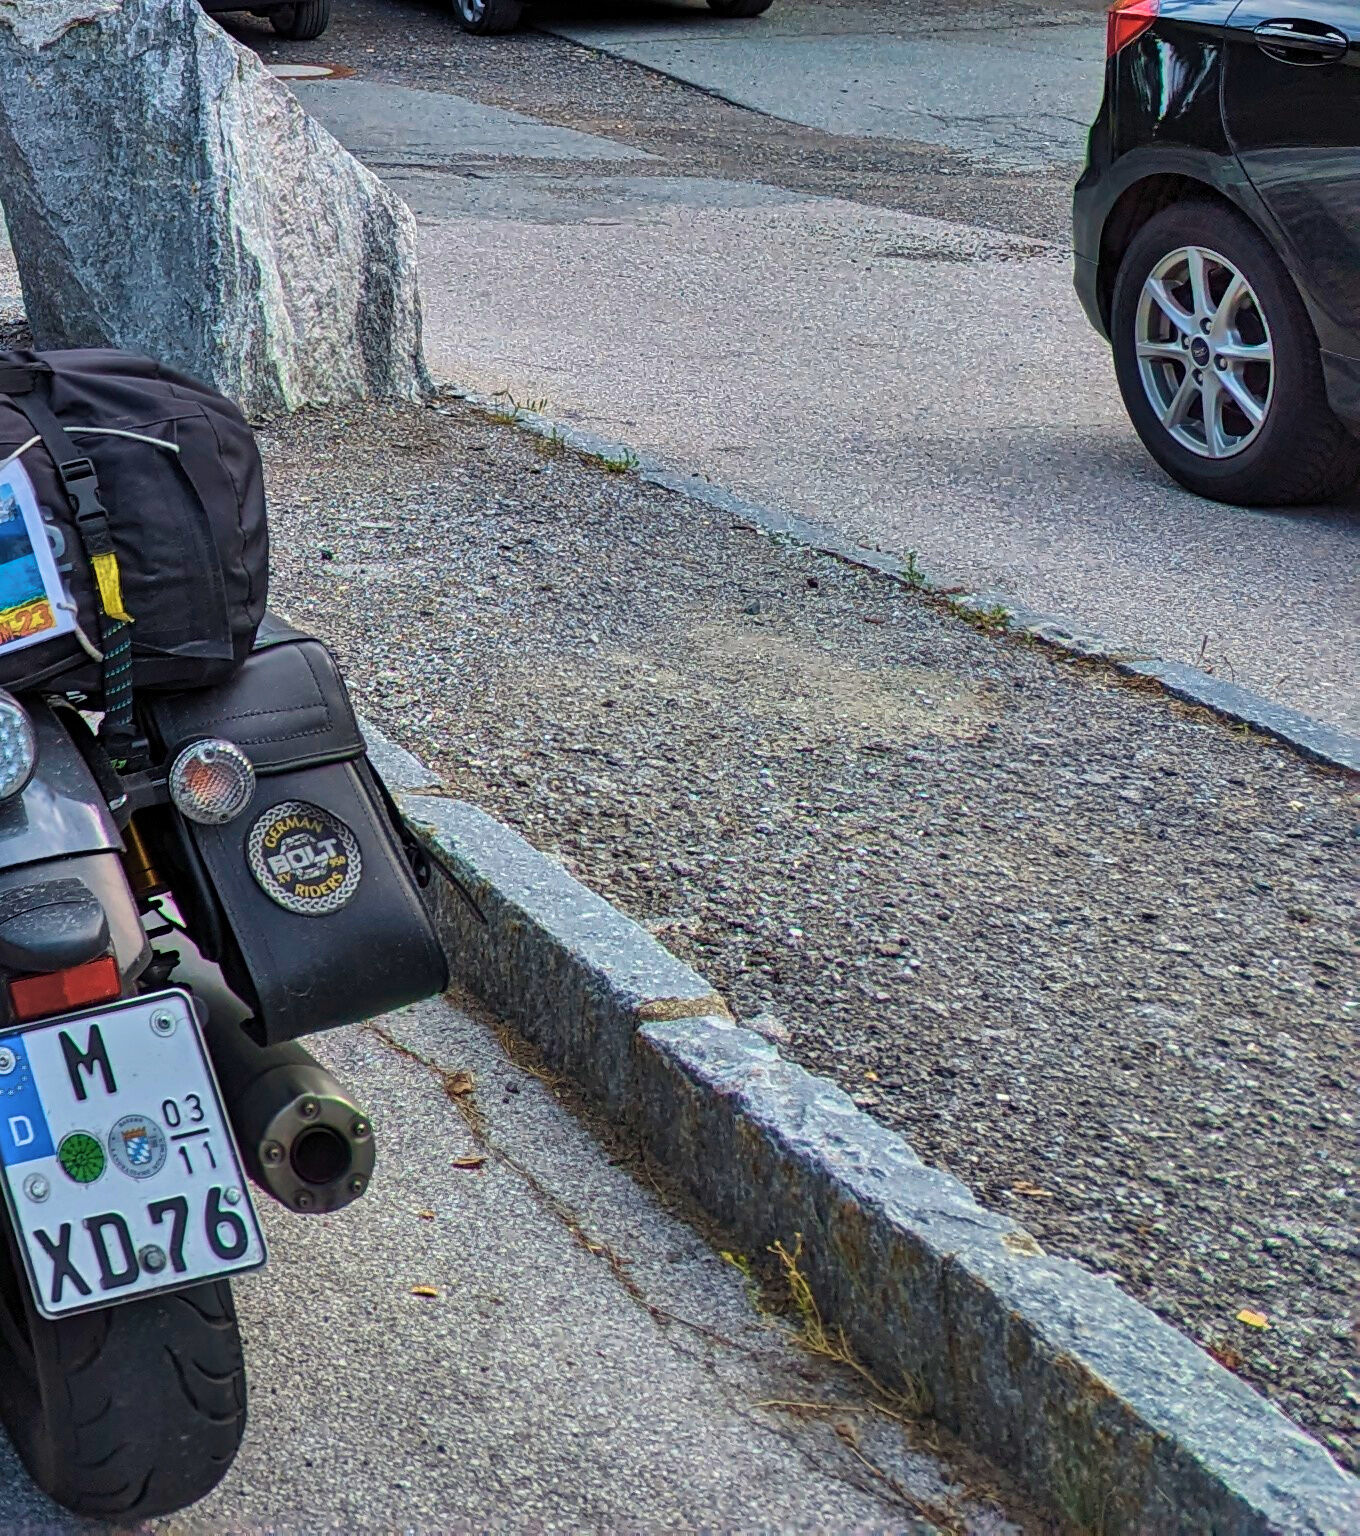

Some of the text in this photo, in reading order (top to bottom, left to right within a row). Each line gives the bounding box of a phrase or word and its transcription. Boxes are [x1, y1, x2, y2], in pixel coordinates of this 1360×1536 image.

[264, 815, 324, 849] GERMAN
[267, 837, 338, 876] BOLT
[295, 872, 343, 896] RIDERS
[58, 1024, 117, 1101] M
[161, 1092, 205, 1128] 03
[8, 1114, 35, 1147] D
[177, 1140, 218, 1176] 11
